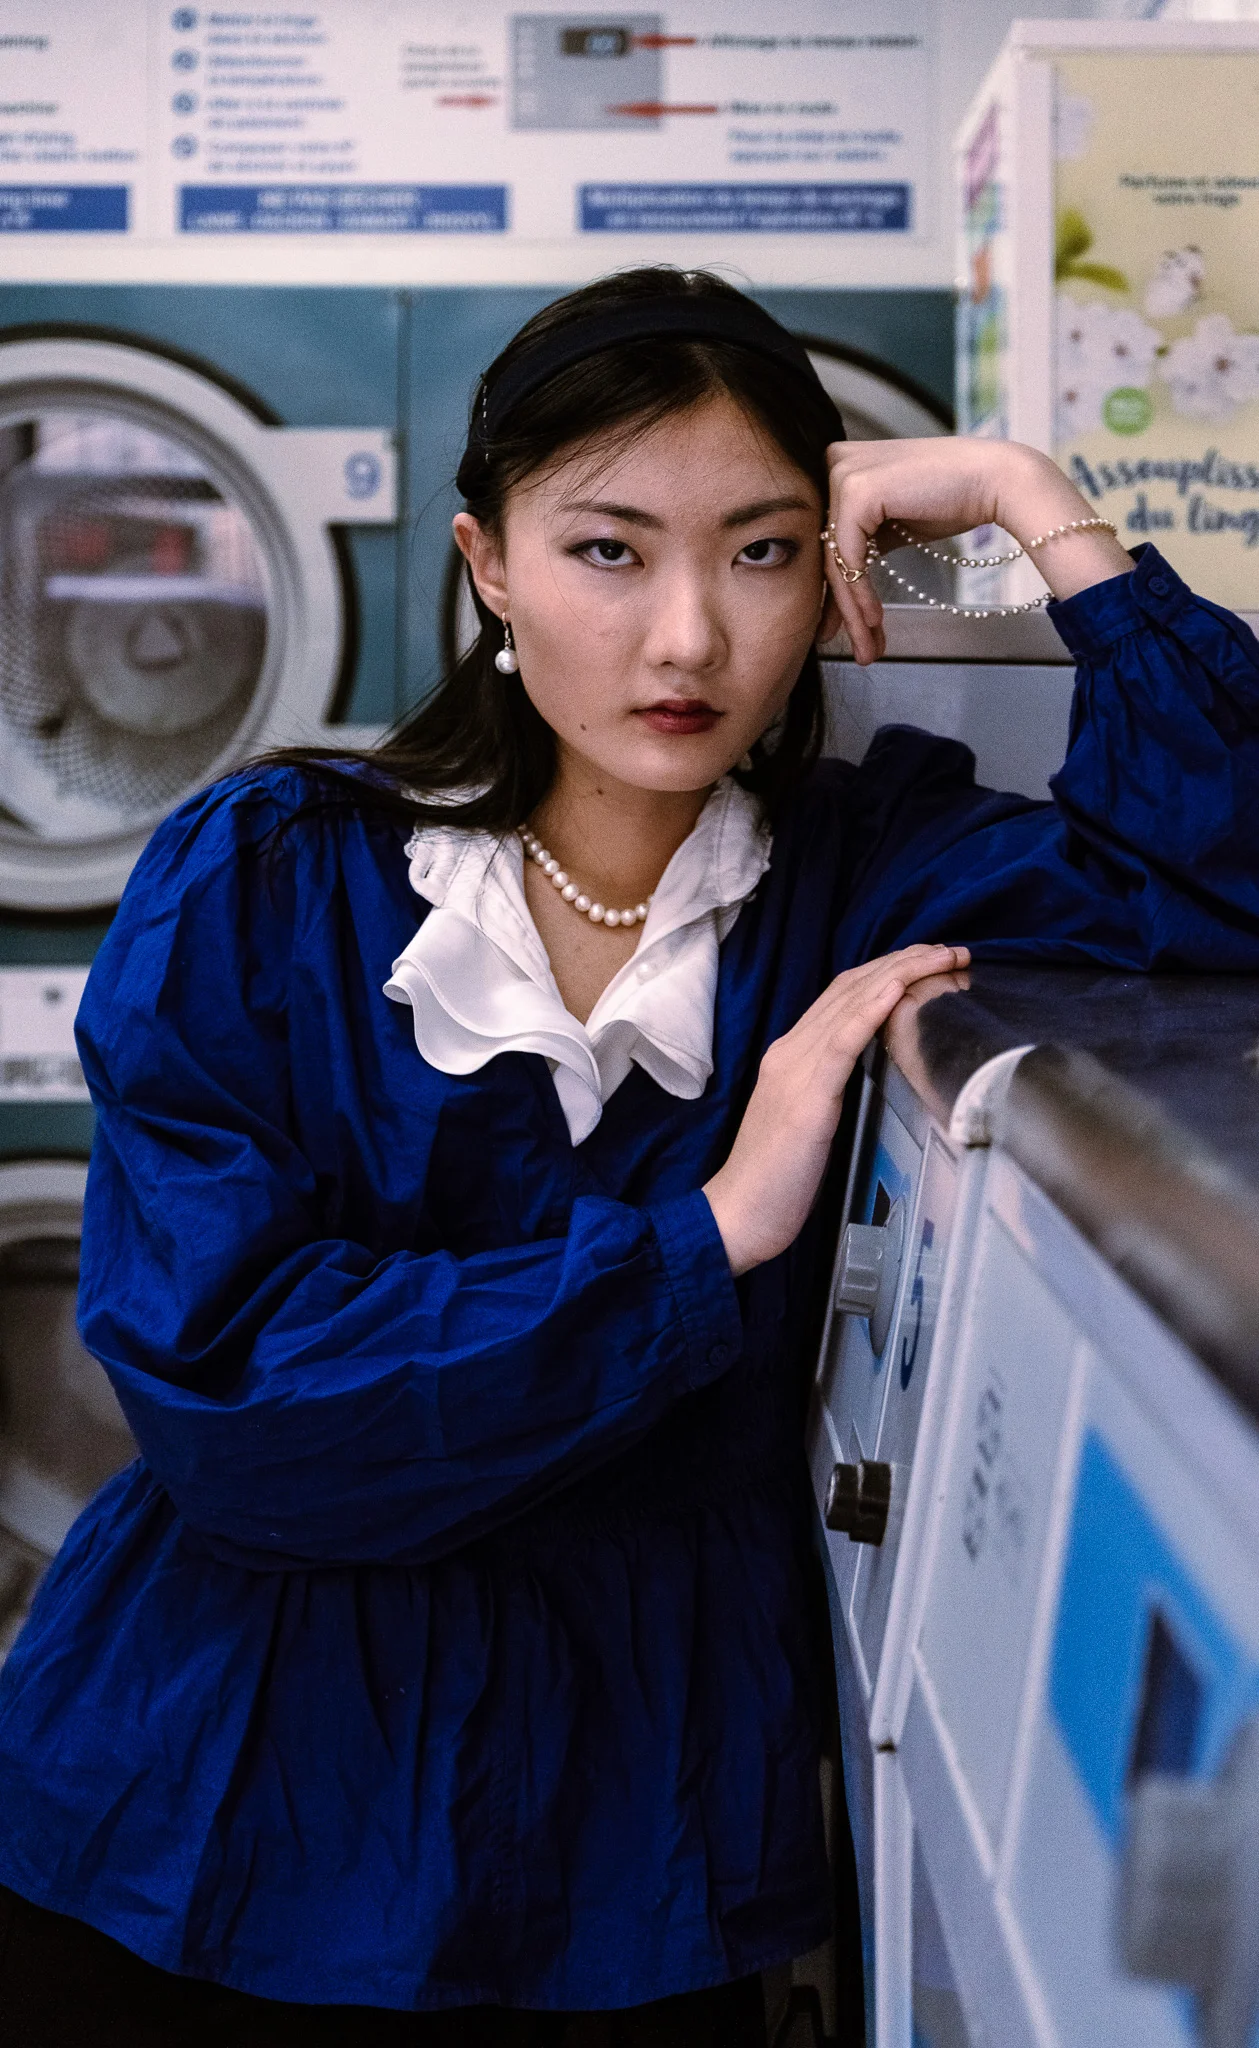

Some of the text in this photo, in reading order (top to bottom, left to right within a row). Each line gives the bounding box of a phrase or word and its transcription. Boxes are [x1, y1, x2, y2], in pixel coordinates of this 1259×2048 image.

[343, 450, 382, 501] 9
[1126, 491, 1174, 533] du
[901, 1217, 935, 1392] 5
